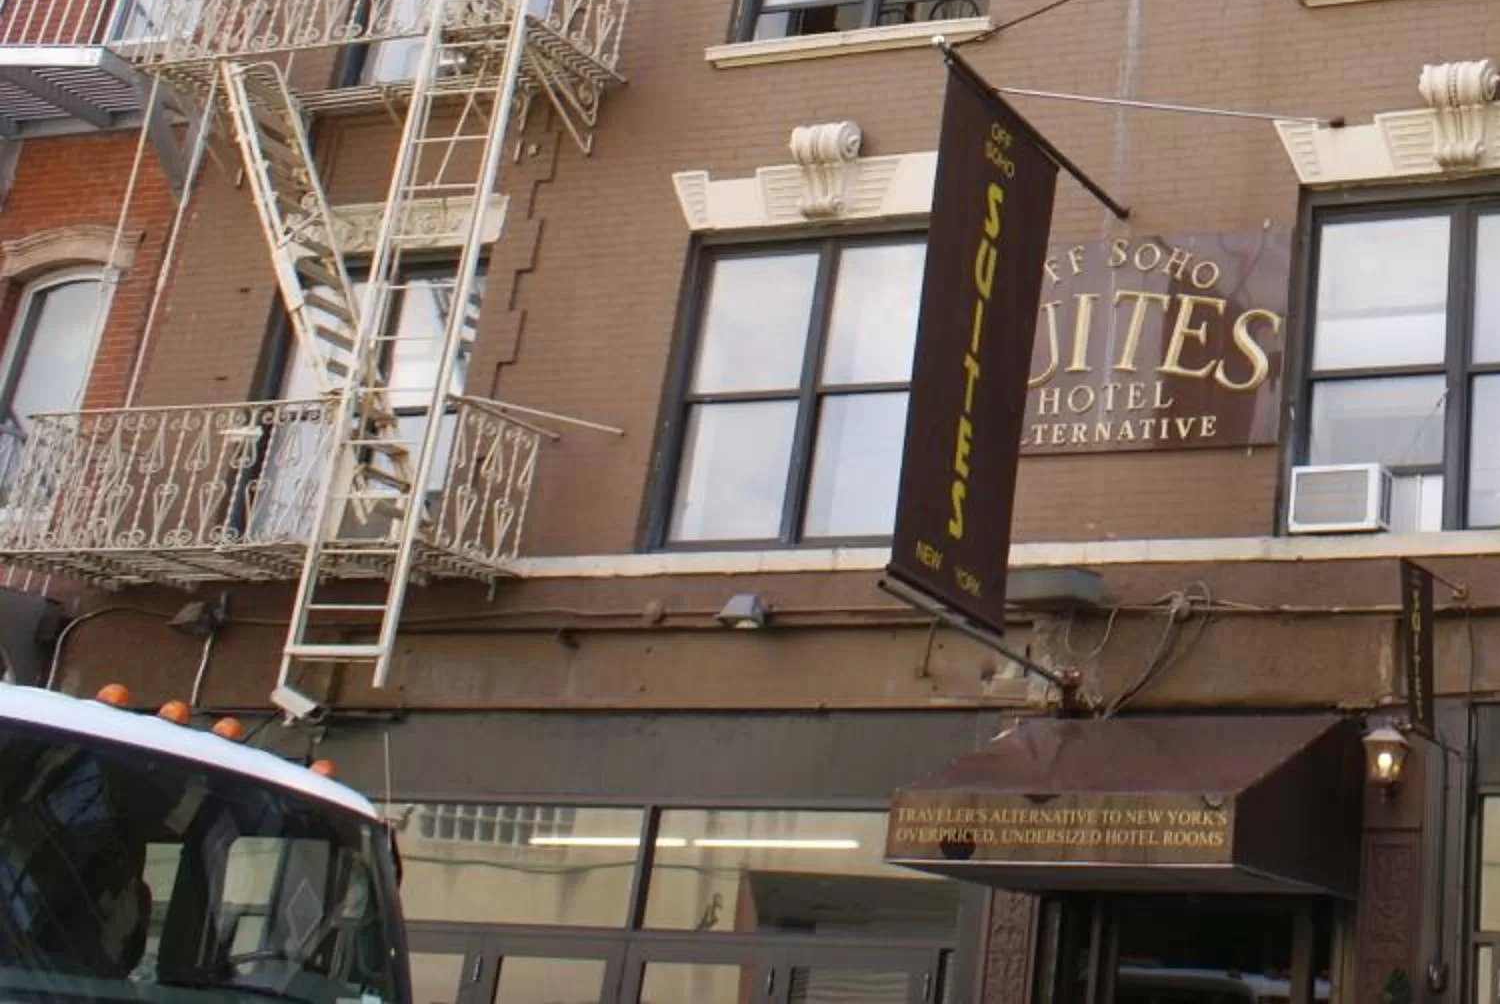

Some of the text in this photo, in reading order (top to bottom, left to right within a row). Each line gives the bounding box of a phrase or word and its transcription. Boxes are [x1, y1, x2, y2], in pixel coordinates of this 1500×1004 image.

[1044, 239, 1219, 288] FF SOHO
[949, 183, 1004, 537] SUITES
[1037, 380, 1174, 415] HOTEL
[1021, 415, 1217, 446] TERNATIVE
[897, 808, 1228, 826] TRAVELER'S ALTERNATIVE TO NEW YORK'S
[896, 827, 1224, 846] OVERPRICED, UNDERSIZED HOTEL ROOMS
